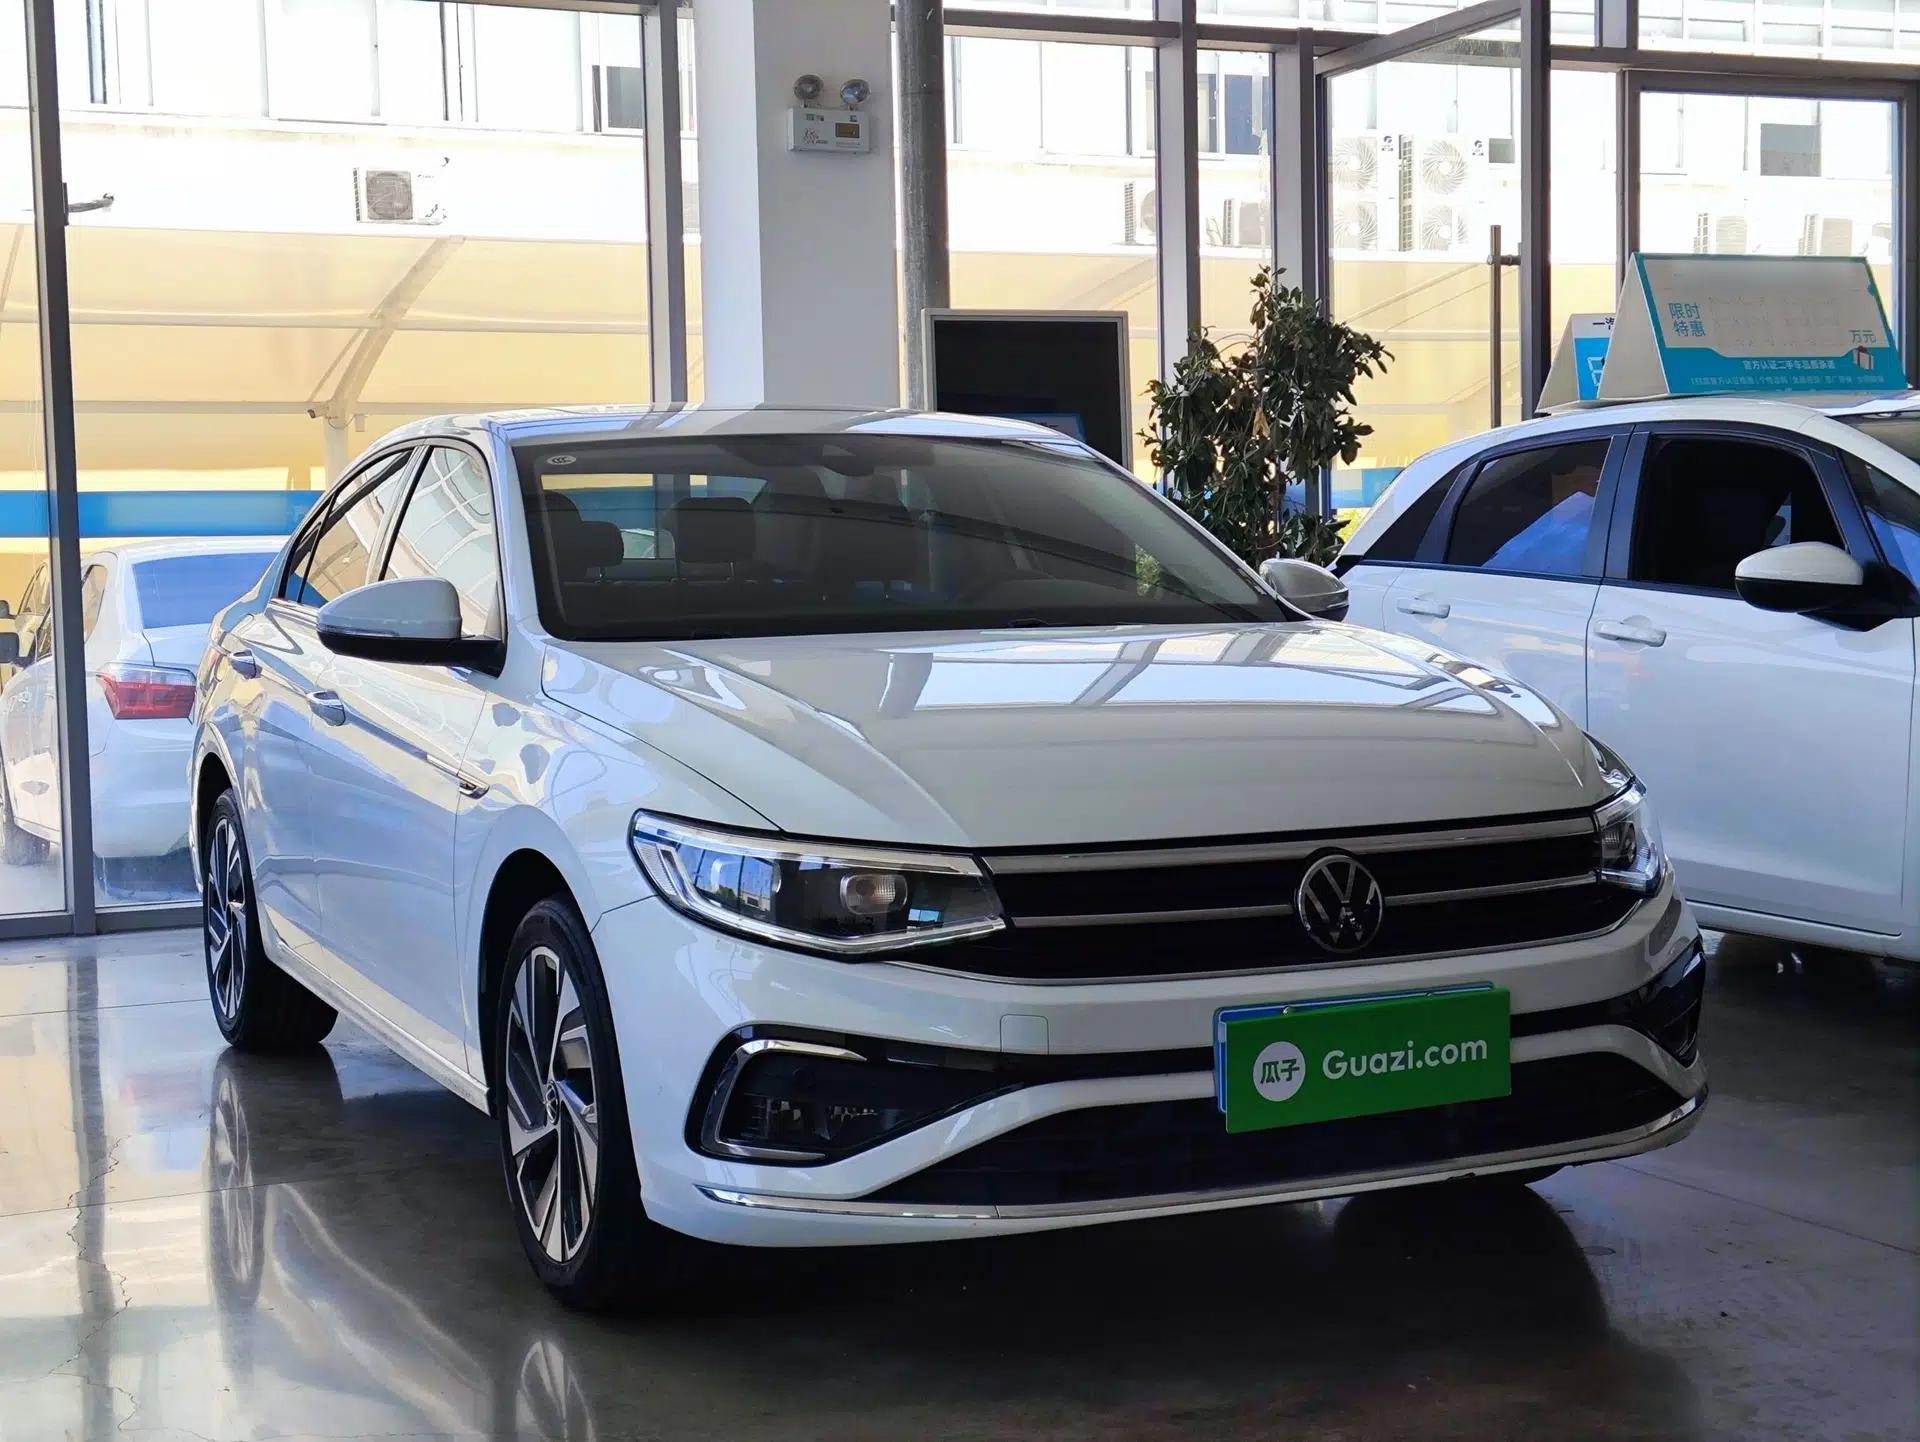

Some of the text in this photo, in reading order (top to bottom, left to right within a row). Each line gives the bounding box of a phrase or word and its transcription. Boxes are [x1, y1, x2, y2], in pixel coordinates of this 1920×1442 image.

[1668, 302, 1700, 320] 限时
[1673, 320, 1706, 337] 特惠
[1850, 329, 1877, 344] 万元
[1322, 1039, 1488, 1080] Guazi.com
[1260, 1058, 1300, 1085] 瓜子
